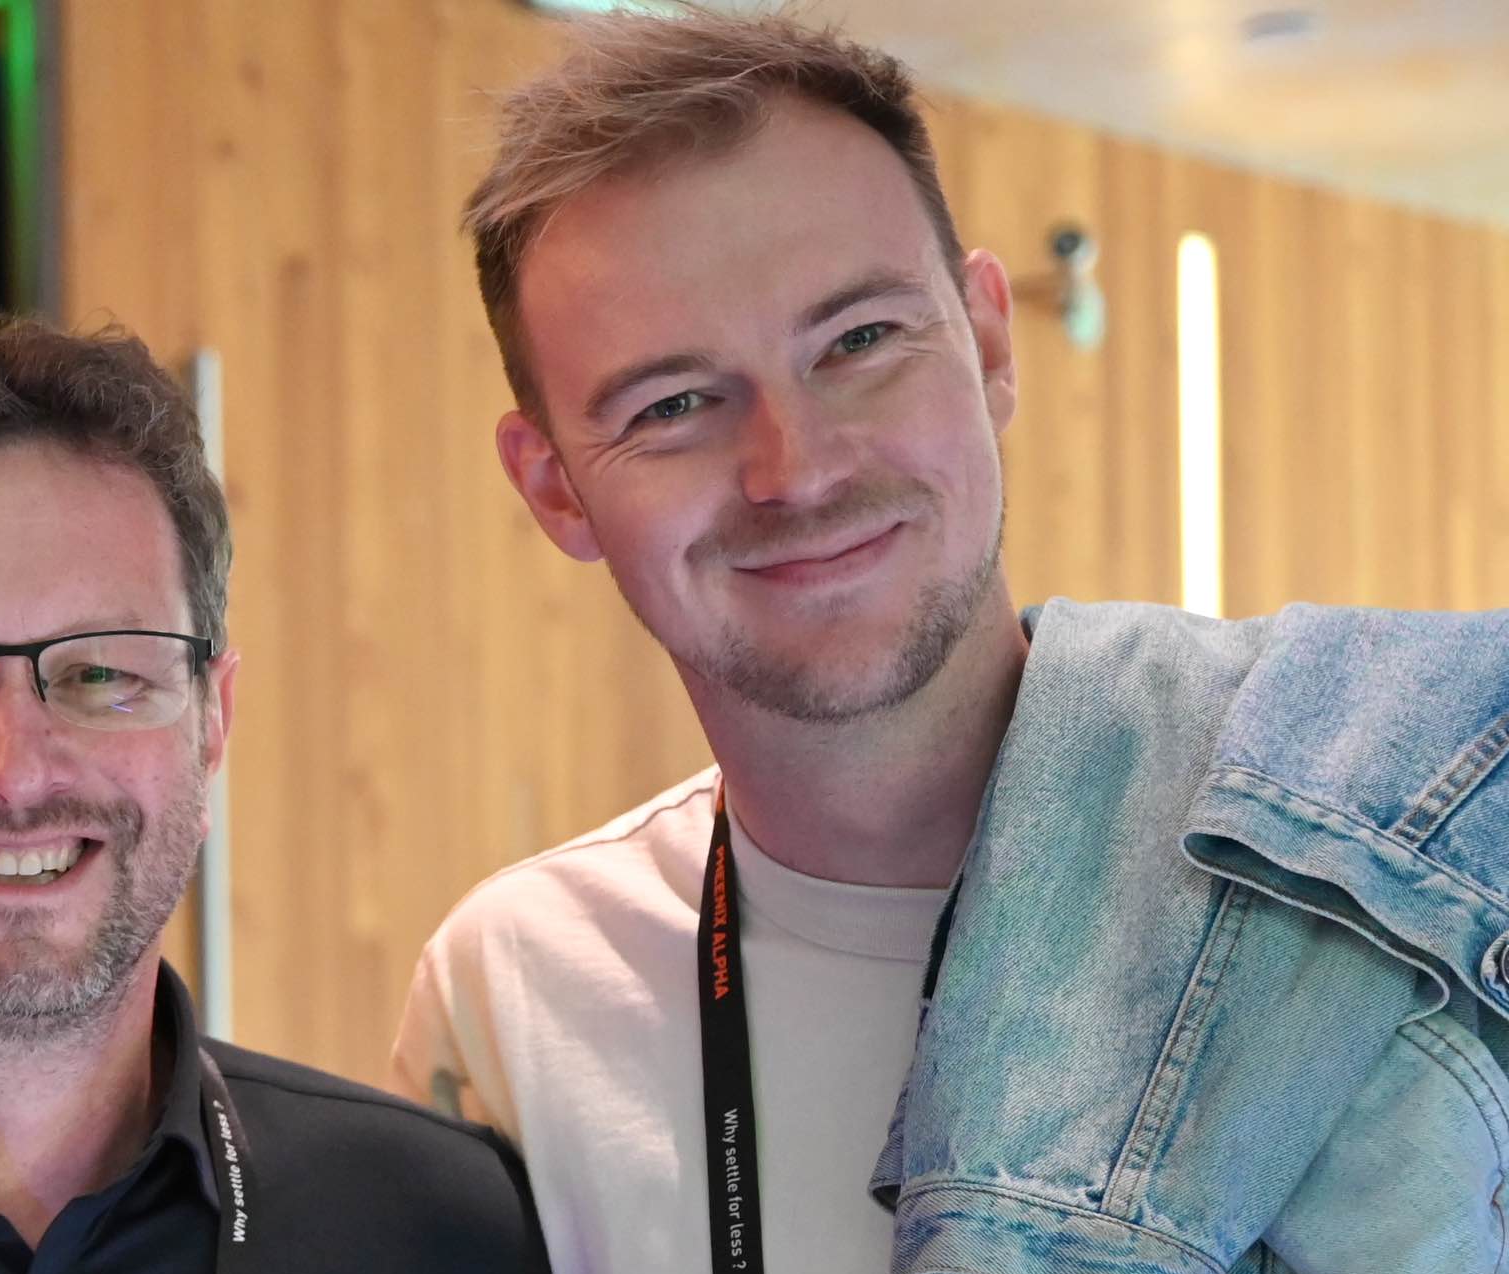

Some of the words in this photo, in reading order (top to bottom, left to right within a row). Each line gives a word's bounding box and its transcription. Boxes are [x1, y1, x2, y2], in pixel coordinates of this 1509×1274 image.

[712, 932, 731, 1000] ALPHA
[217, 1112, 233, 1140] less
[722, 1108, 739, 1144] Why
[225, 1141, 238, 1163] for
[229, 1164, 245, 1207] settle
[725, 1147, 742, 1193] settle
[728, 1196, 744, 1219] for
[233, 1209, 248, 1242] Why
[729, 1223, 745, 1257] less
[732, 1260, 747, 1270] ?
